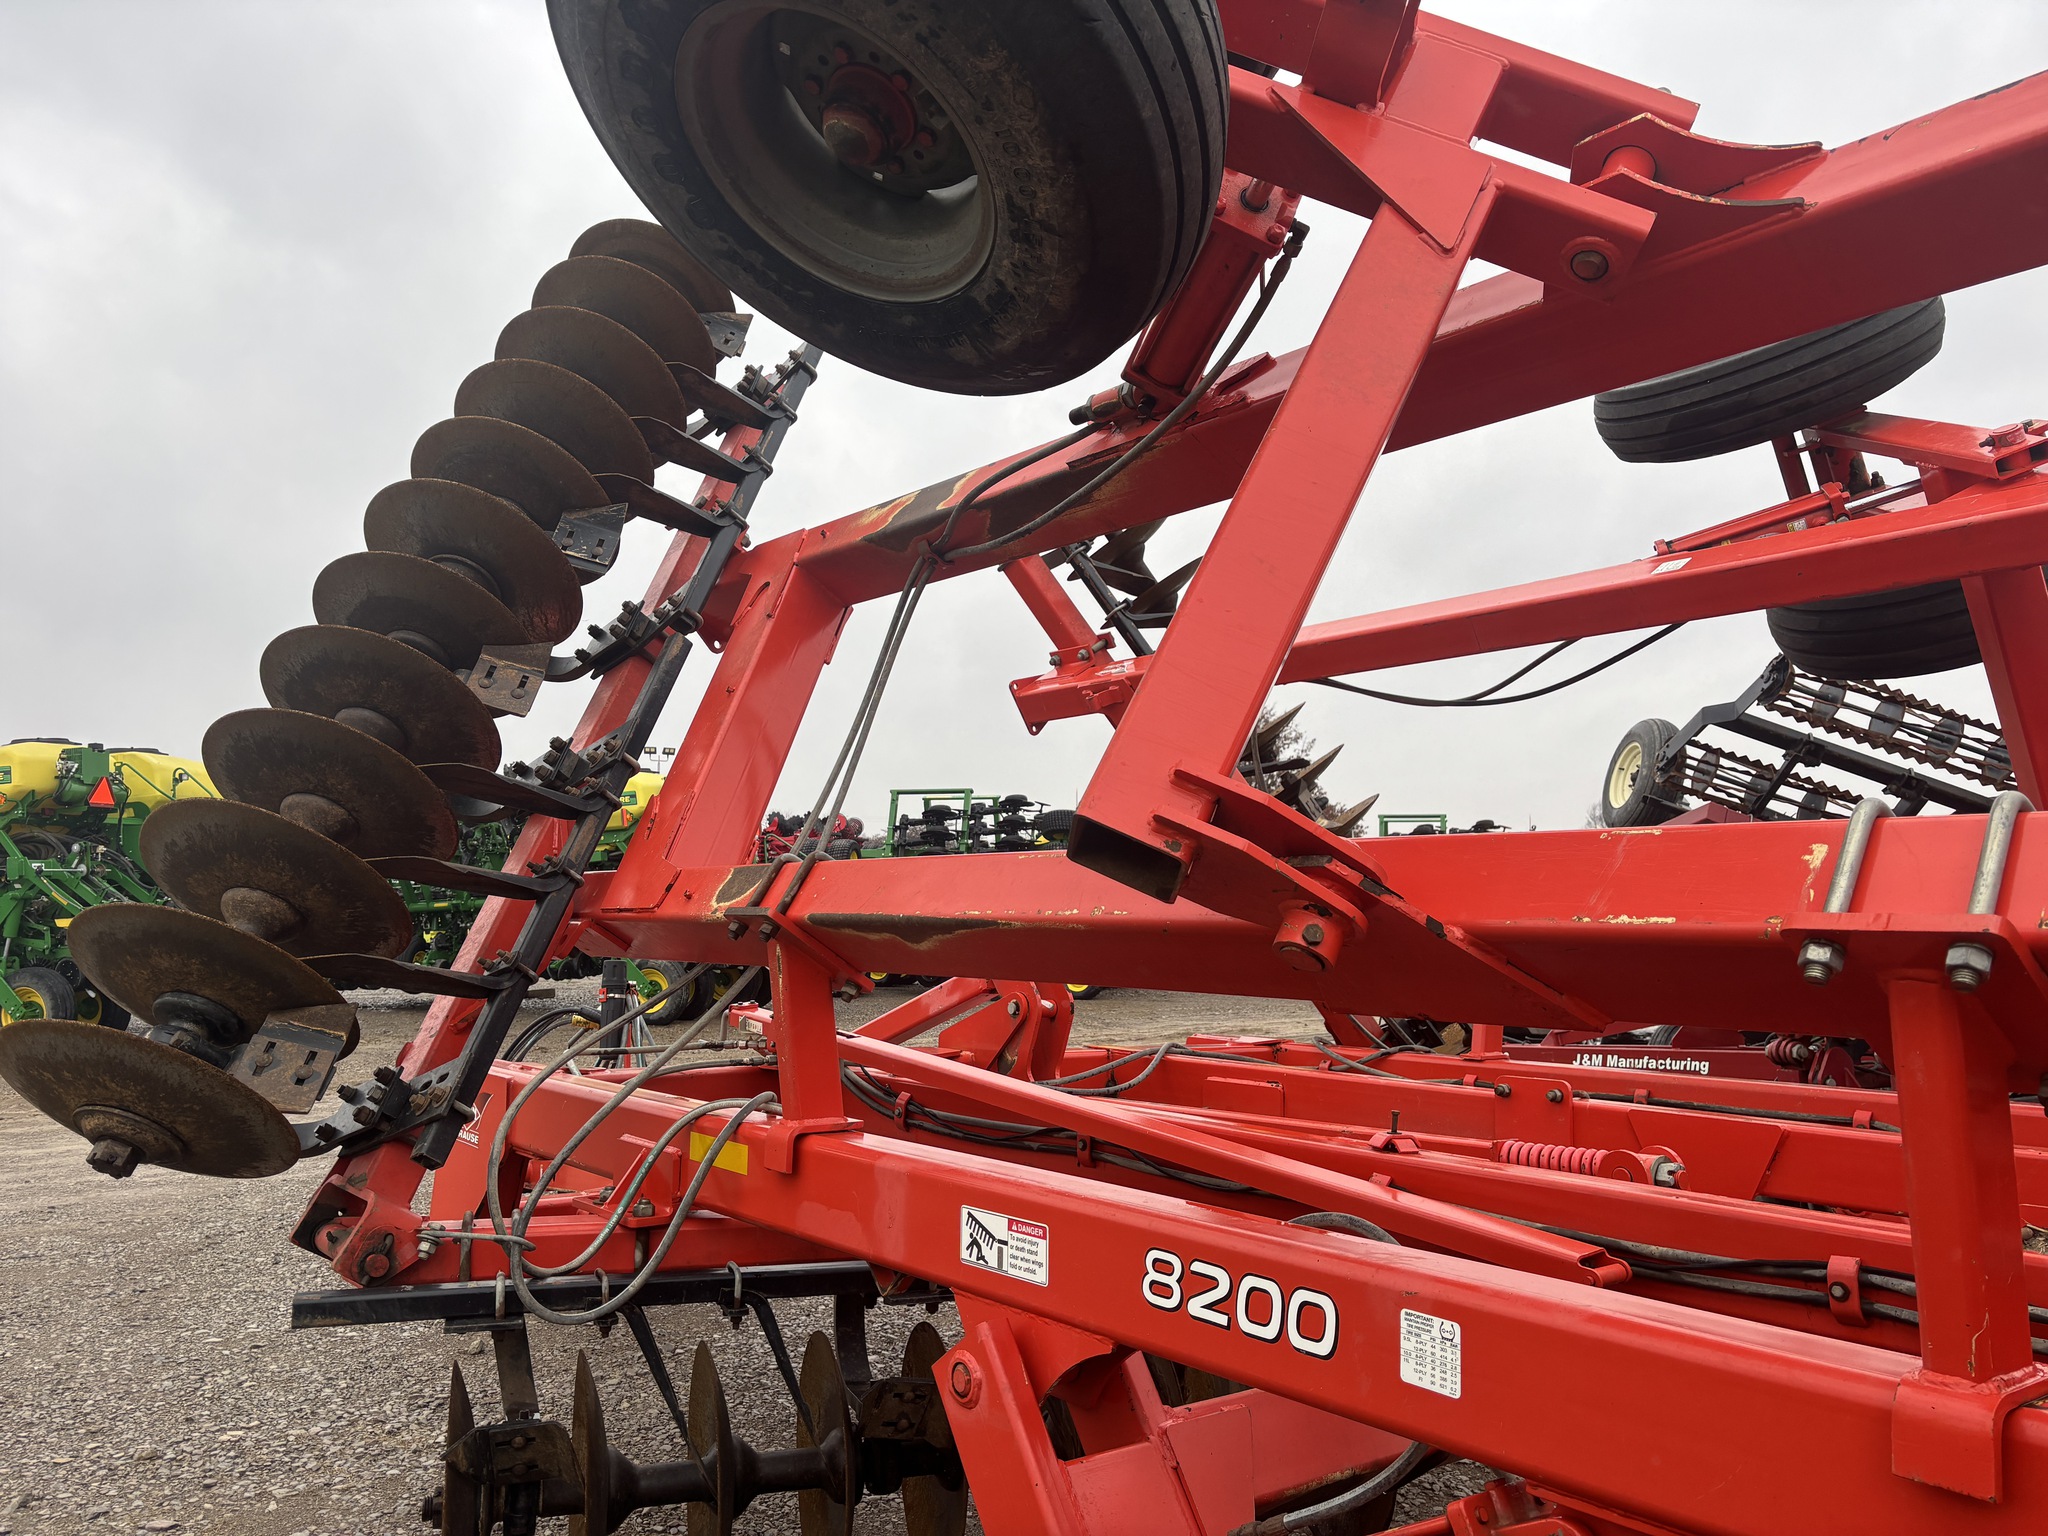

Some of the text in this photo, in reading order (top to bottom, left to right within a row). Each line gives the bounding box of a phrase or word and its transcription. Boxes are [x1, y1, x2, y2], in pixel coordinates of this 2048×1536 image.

[1572, 1053, 1709, 1074] J&M Manufacturing
[458, 1130, 479, 1144] RAUSE
[1018, 1224, 1043, 1236] DANGER
[1016, 1236, 1027, 1244] avoid
[1027, 1238, 1039, 1248] injury
[1015, 1245, 1026, 1253] death
[1027, 1247, 1038, 1256] stand
[1010, 1252, 1043, 1268] clear when wings
[1023, 1265, 1037, 1275] unfold.
[1141, 1247, 1339, 1361] 8200
[1405, 1311, 1434, 1323] IMPORTANT:
[1415, 1324, 1432, 1334] PRESSURE
[1419, 1321, 1434, 1329] PROPER
[1413, 1346, 1427, 1354] 12-PLY
[1413, 1368, 1427, 1376] 12-PLY
